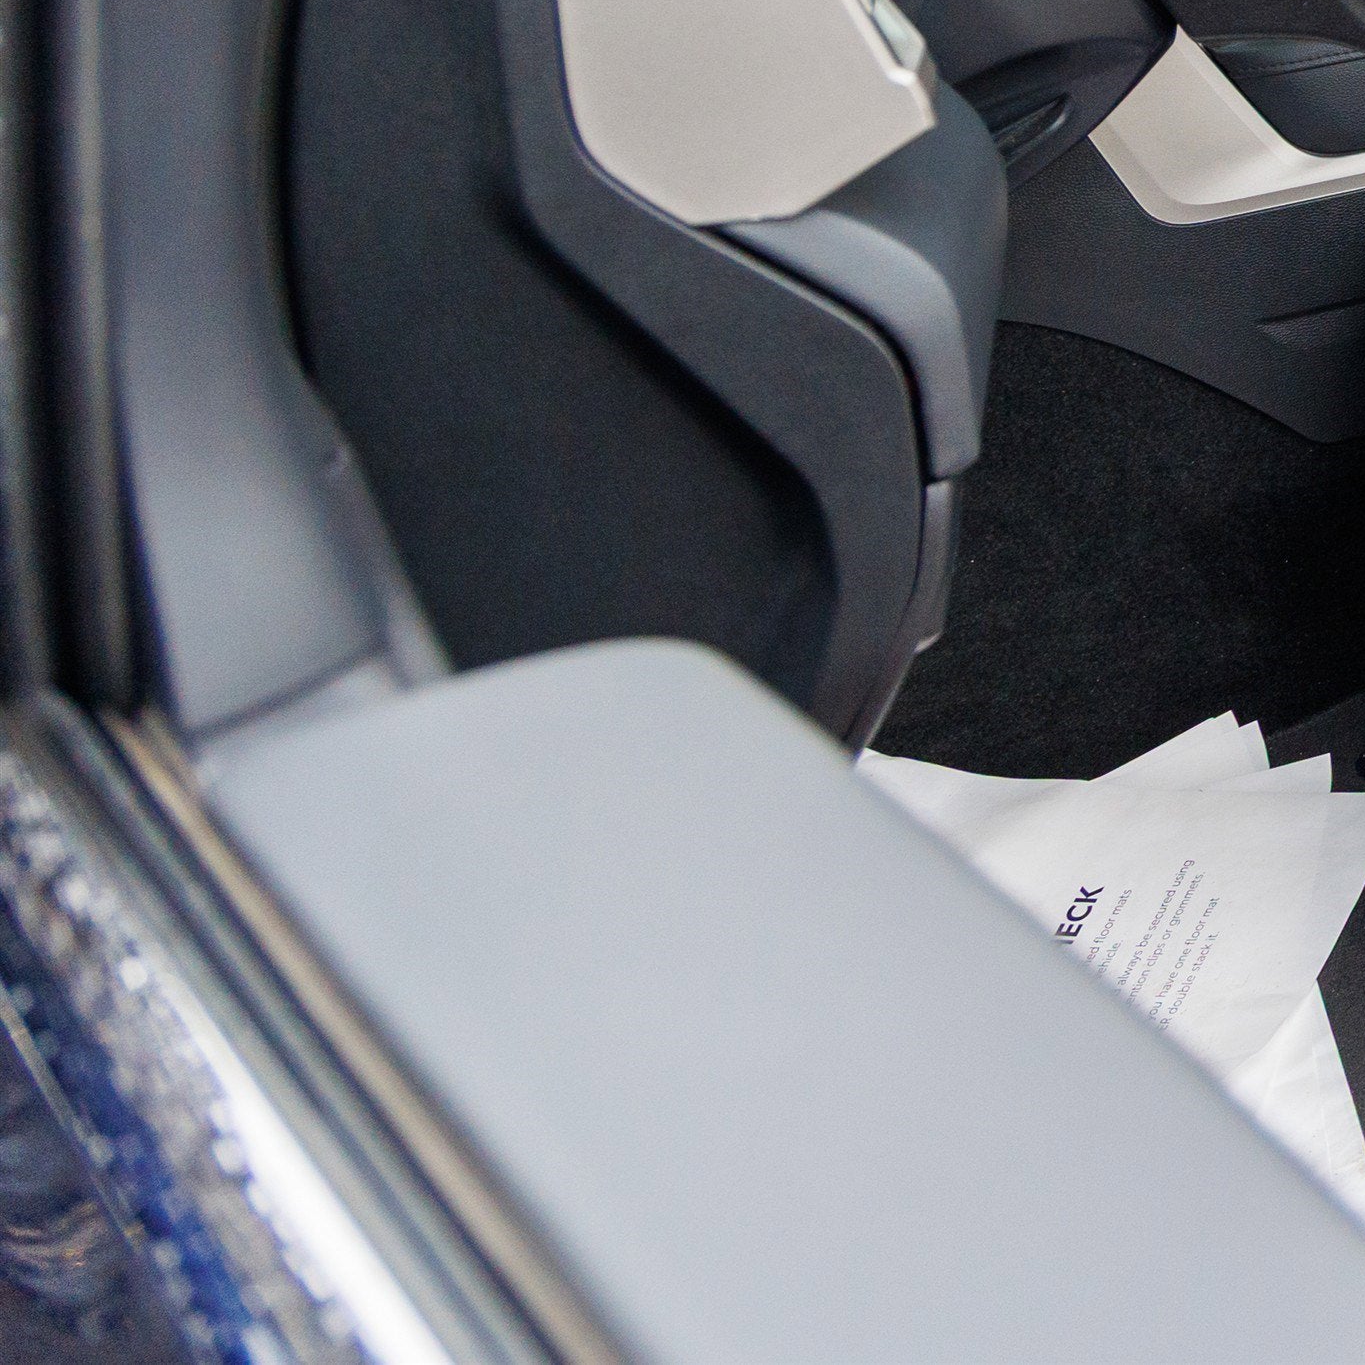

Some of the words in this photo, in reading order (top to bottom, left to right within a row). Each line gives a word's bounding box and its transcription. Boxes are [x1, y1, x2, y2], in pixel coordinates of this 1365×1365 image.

[1094, 918, 1115, 943] floor
[1113, 889, 1132, 915] mats
[1118, 950, 1142, 985] always
[1136, 934, 1152, 947] be
[1149, 890, 1176, 931] secured
[1172, 859, 1194, 887] using
[1126, 969, 1150, 1006] ention
[1147, 942, 1166, 967] clips
[1162, 929, 1171, 940] or
[1169, 871, 1206, 927] grommets.
[1155, 971, 1178, 998] have
[1174, 948, 1191, 969] one
[1185, 920, 1206, 946] floor
[1203, 897, 1220, 917] mat
[1169, 974, 1196, 1014] double
[1191, 943, 1213, 971] stack
[1208, 931, 1220, 941] it.
